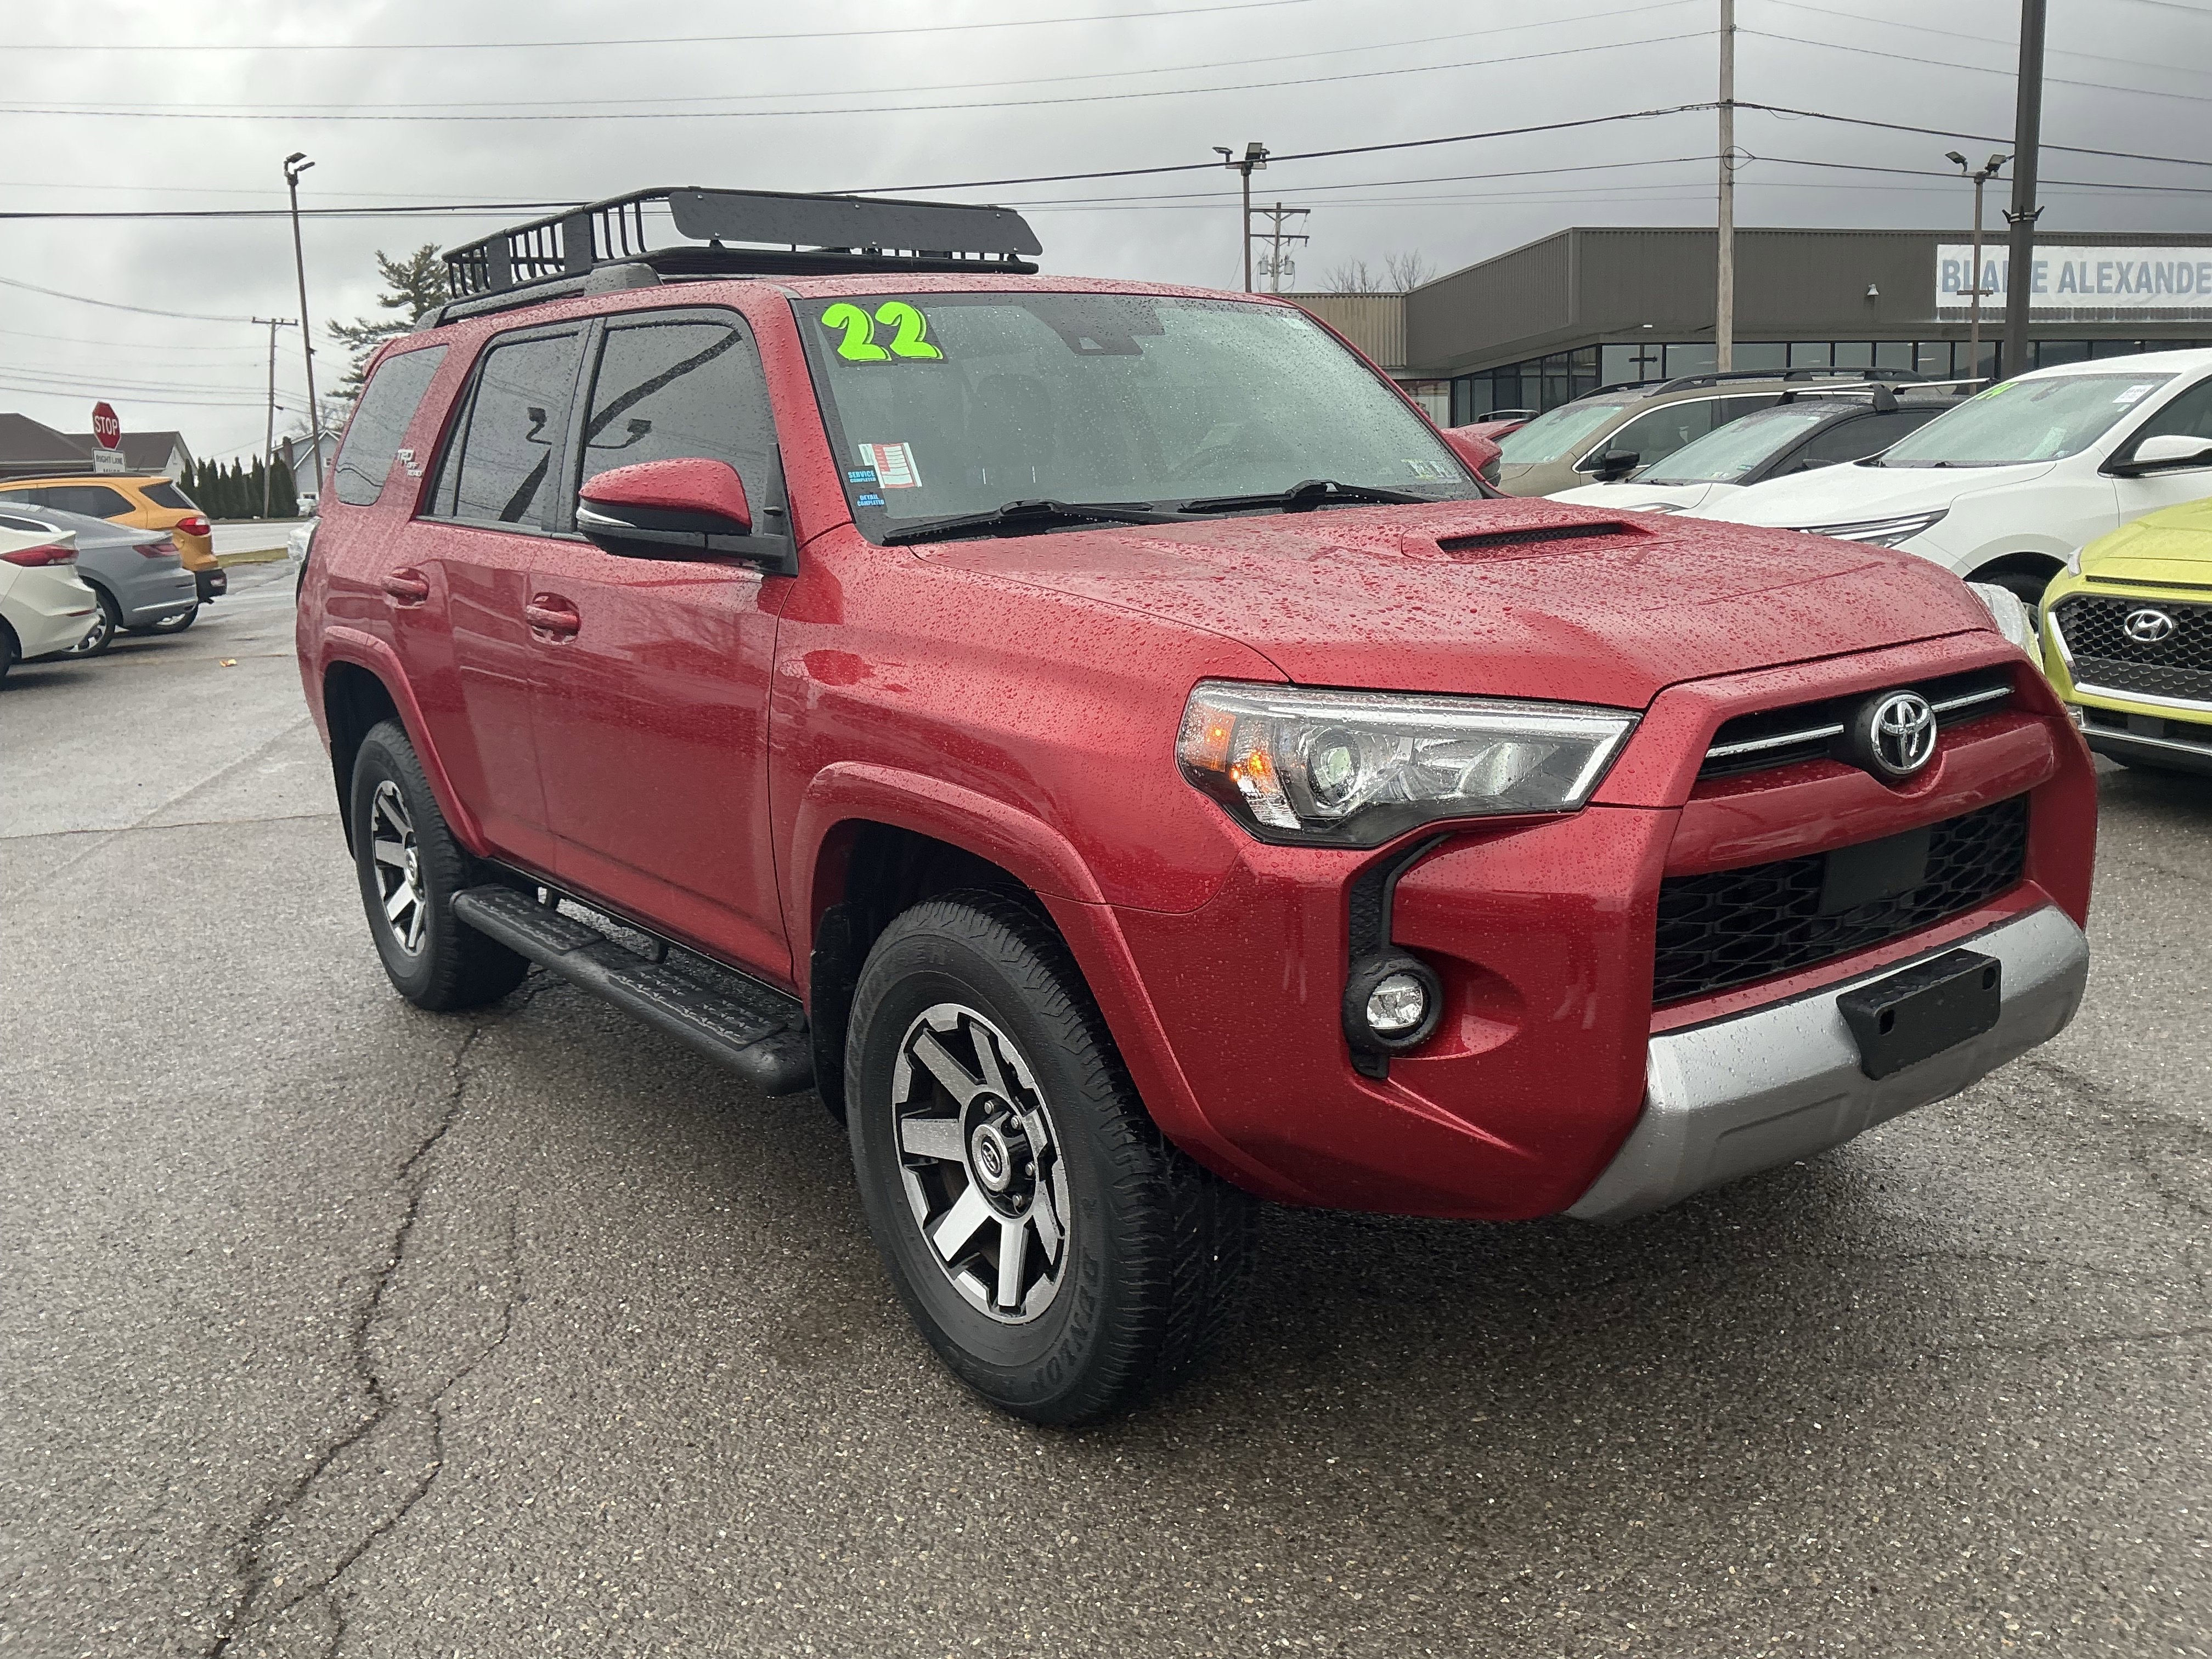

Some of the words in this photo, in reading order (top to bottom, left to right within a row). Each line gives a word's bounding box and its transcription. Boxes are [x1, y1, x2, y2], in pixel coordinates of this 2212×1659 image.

[1942, 260, 2048, 293] BLAE
[822, 301, 944, 362] 22
[95, 415, 118, 436] STOP
